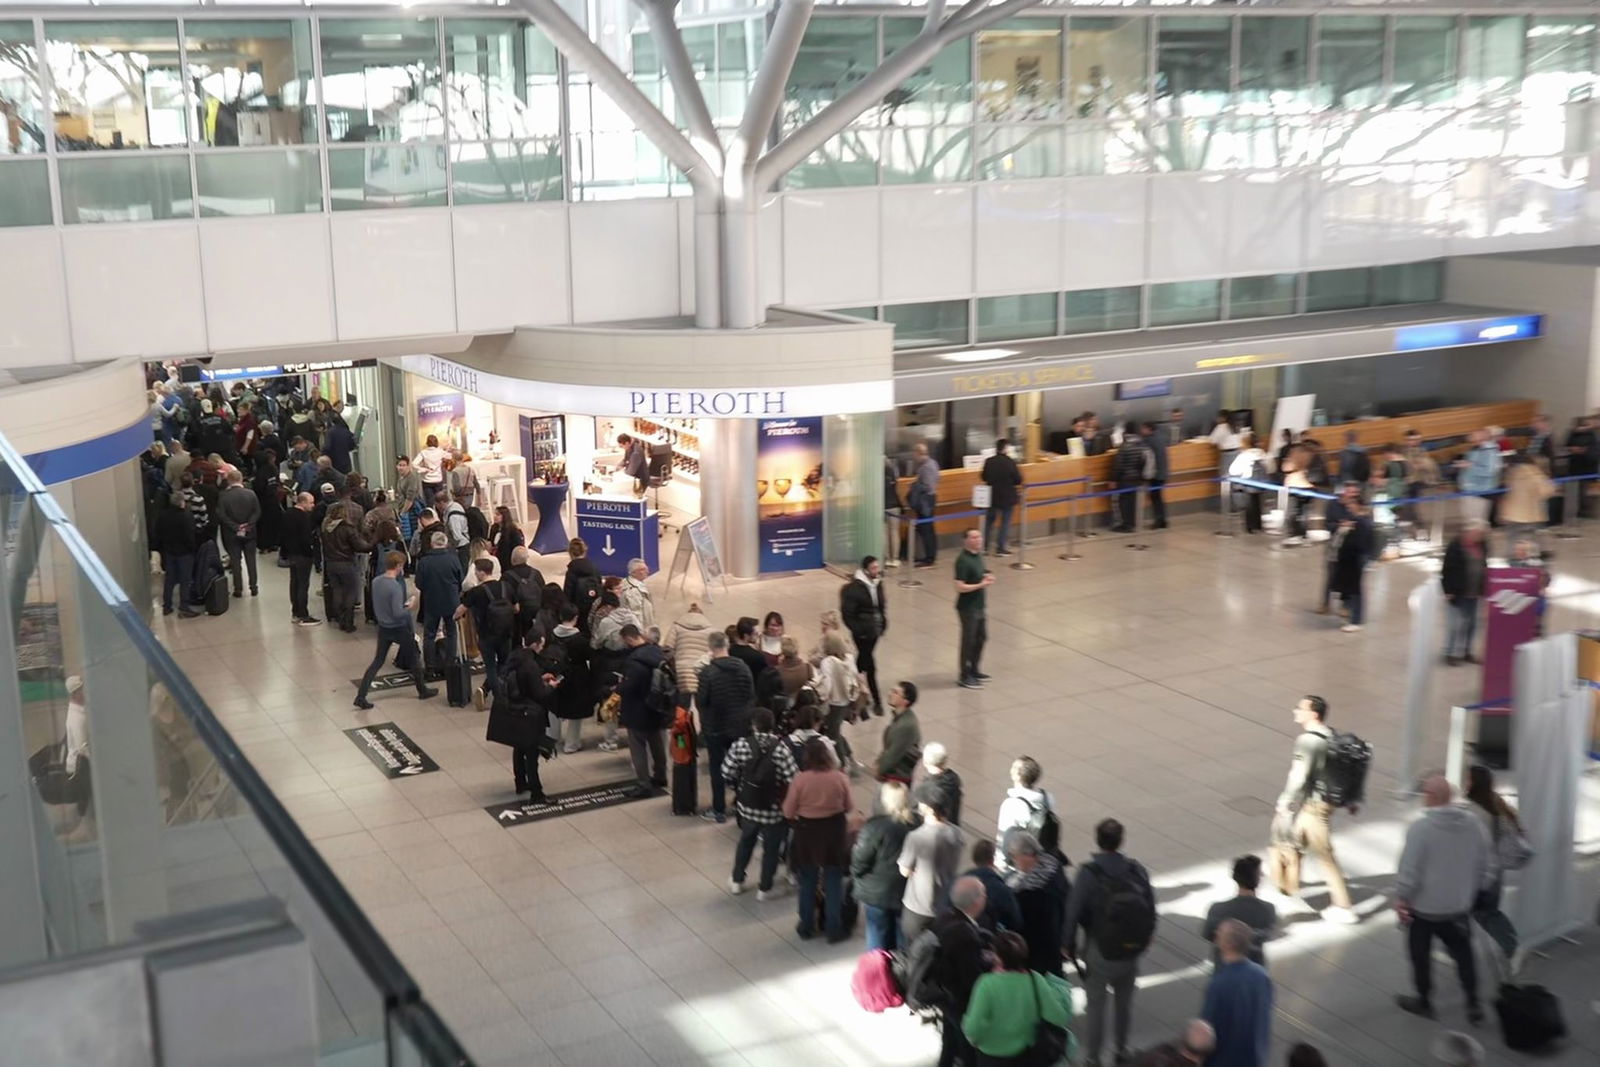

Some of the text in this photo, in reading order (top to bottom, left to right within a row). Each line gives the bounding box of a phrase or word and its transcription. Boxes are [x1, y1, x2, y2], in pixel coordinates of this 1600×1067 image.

[430, 357, 478, 393] PIEROTH
[952, 373, 1017, 392] TICKETS
[1034, 364, 1095, 382] SERVICE
[630, 391, 787, 415] PIEROTH
[586, 502, 631, 513] PIEROTH
[582, 521, 635, 531] TASTING LANE
